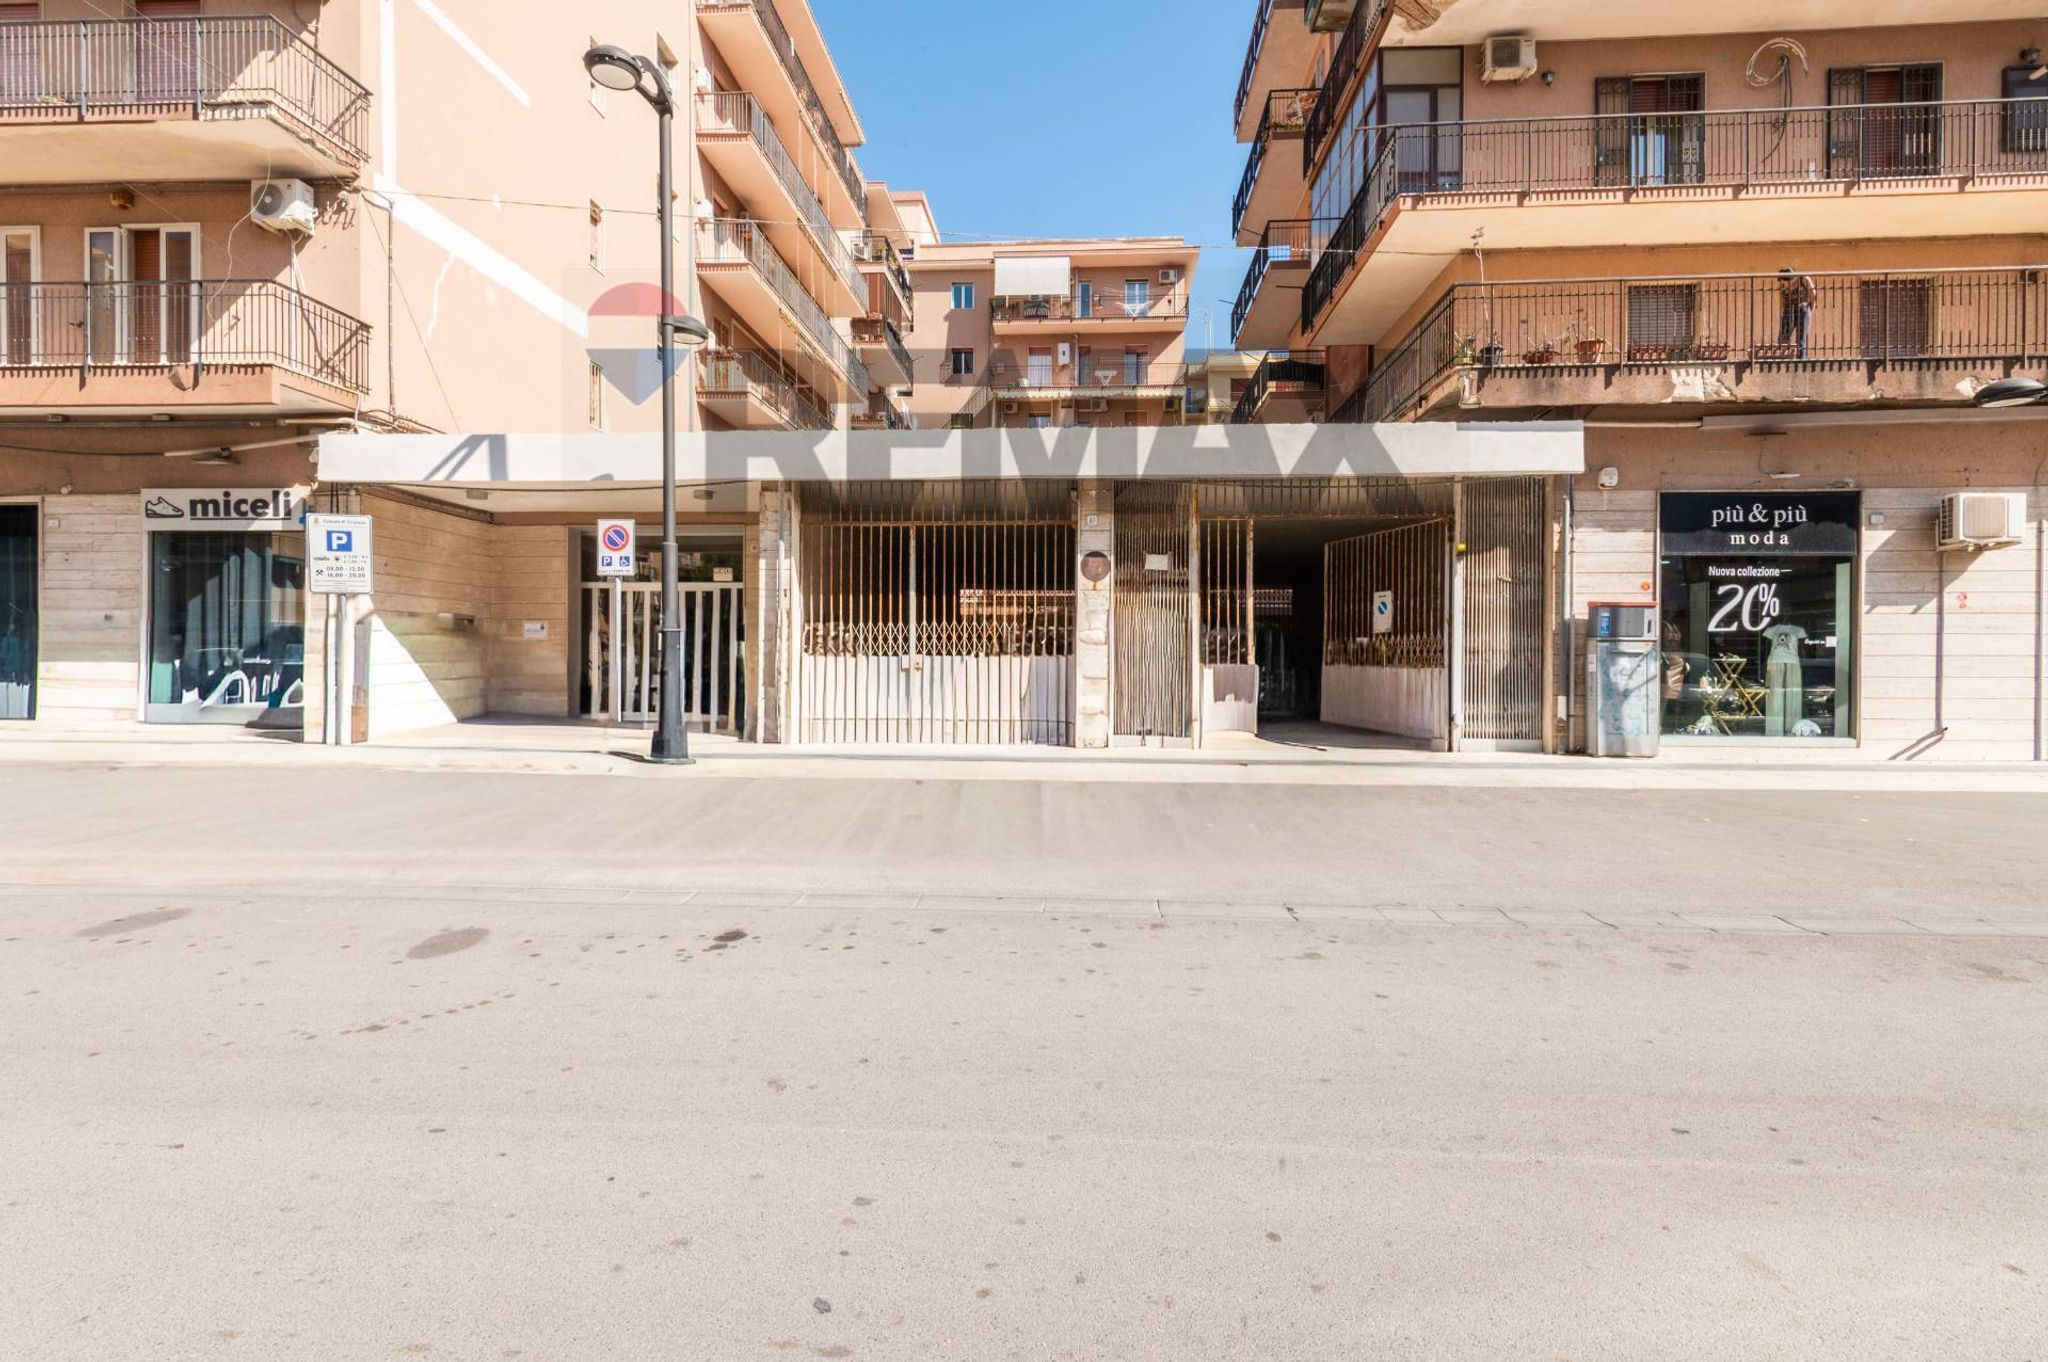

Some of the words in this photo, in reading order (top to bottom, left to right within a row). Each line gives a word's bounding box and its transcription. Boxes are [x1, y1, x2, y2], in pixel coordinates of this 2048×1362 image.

[189, 490, 292, 517] miceli
[1711, 504, 1745, 528] più
[1748, 503, 1769, 523] &
[1773, 504, 1808, 528] più
[331, 532, 348, 550] P
[1730, 530, 1790, 545] moda
[1708, 566, 1736, 577] Nuova
[1737, 566, 1780, 577] collezione
[1706, 583, 1780, 632] 20%
